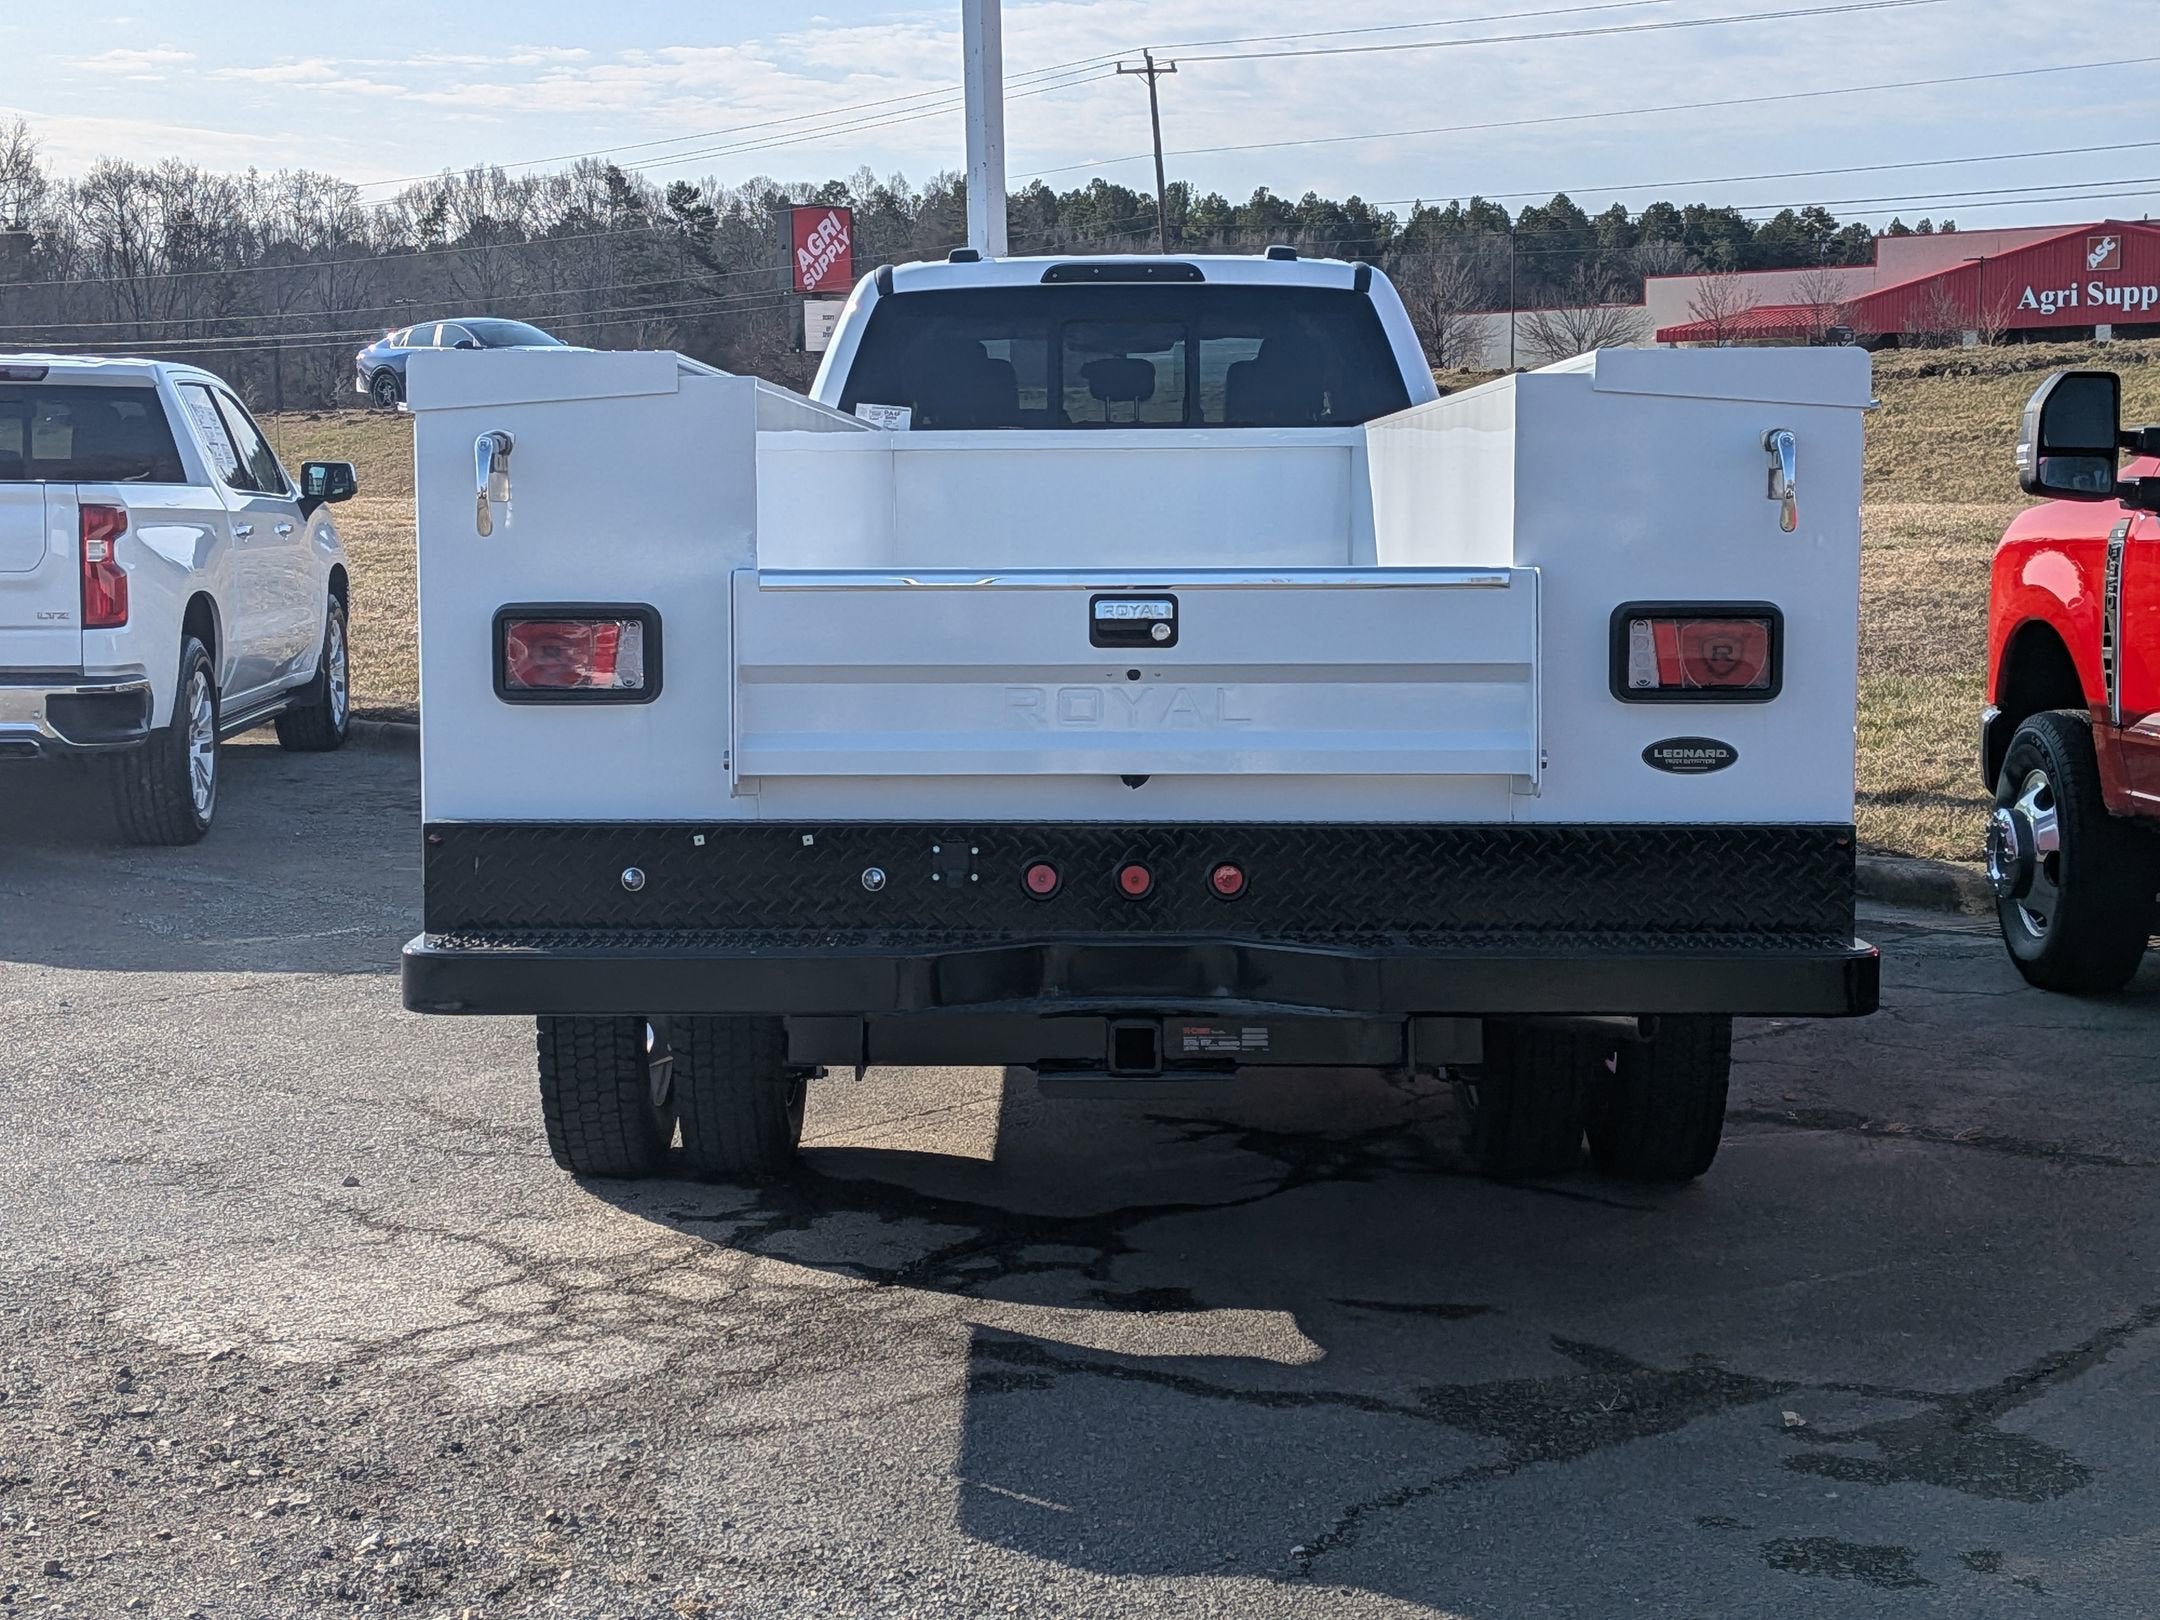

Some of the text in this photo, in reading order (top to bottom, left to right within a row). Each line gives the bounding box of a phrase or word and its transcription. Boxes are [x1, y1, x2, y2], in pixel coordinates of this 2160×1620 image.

[797, 210, 841, 273] AGRI
[803, 226, 850, 290] SUPPLY
[2088, 236, 2116, 268] ASC
[2017, 281, 2160, 315] Agri Supp
[37, 612, 70, 620] LTZ
[1103, 604, 1164, 617] ROYAL
[1005, 687, 1253, 727] ROYAL
